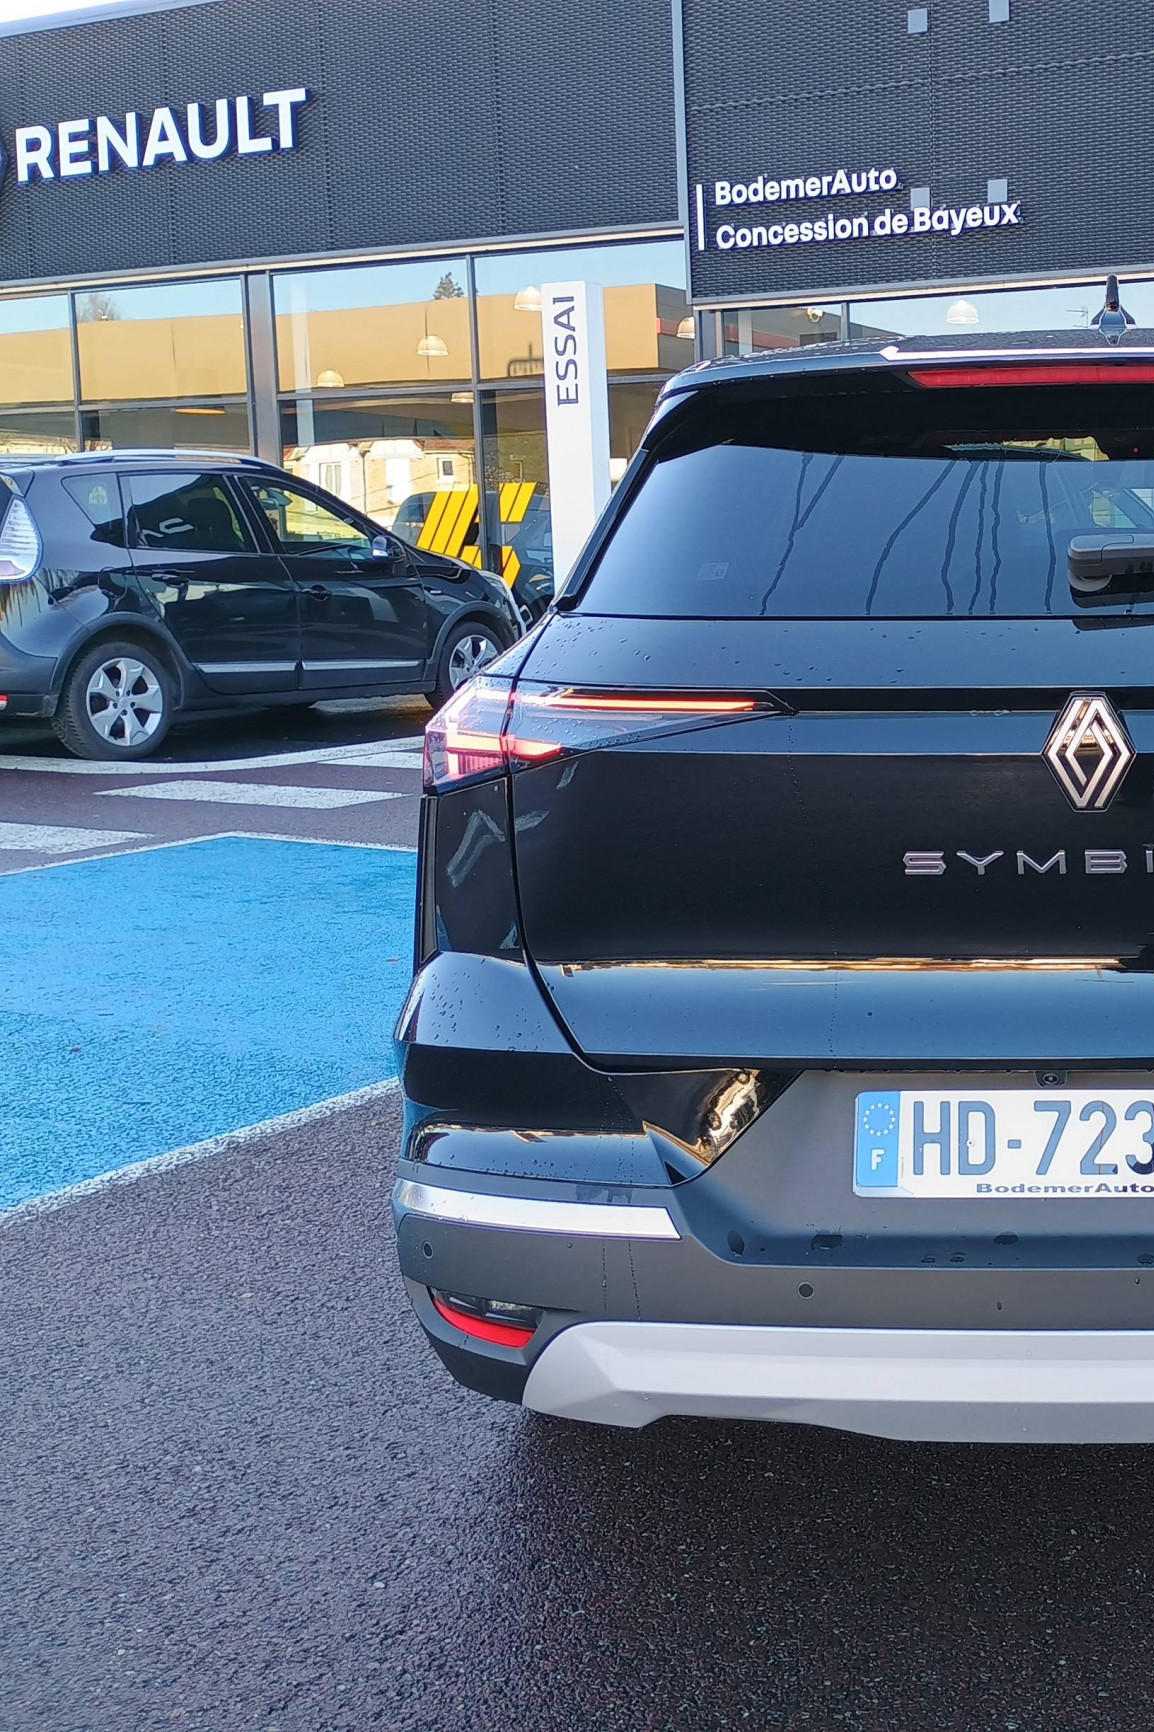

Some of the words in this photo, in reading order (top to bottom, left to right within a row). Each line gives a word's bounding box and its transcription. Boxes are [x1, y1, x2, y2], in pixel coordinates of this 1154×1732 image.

[15, 87, 307, 183] RENAULT
[715, 167, 898, 206] BodemerAuto
[716, 213, 869, 250] Concession
[873, 208, 909, 235] de
[913, 201, 1020, 237] Bayeux
[552, 296, 579, 407] ESSAI
[870, 1148, 886, 1171] F
